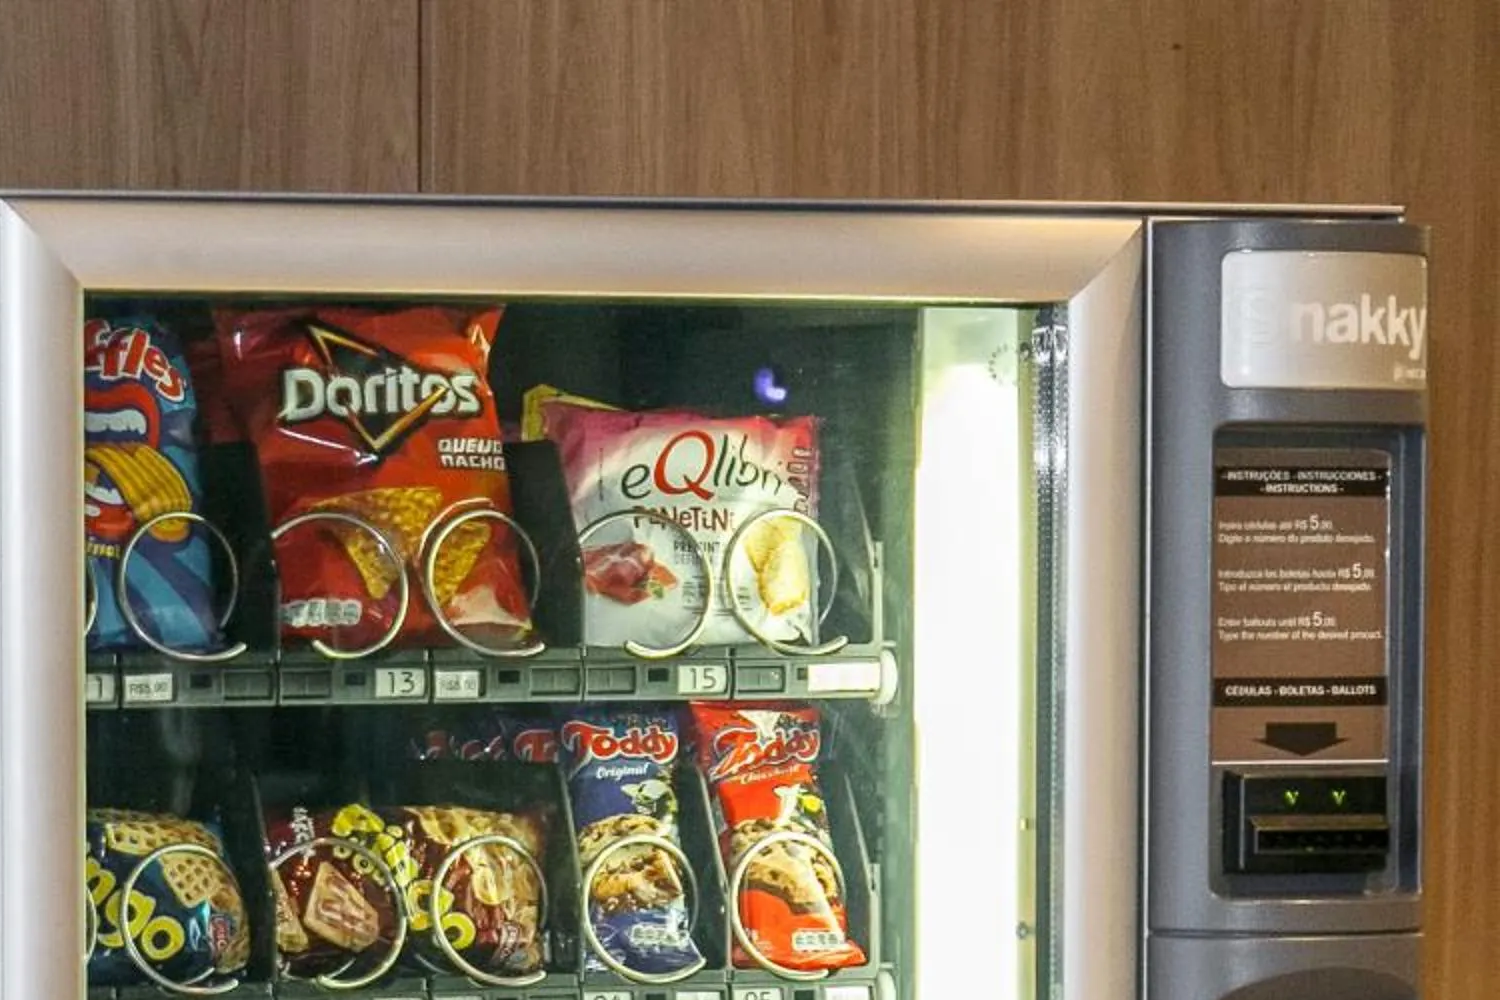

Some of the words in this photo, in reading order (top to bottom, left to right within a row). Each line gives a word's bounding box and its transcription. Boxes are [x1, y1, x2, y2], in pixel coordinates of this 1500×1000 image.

[1290, 292, 1427, 361] nakky
[84, 319, 187, 402] ffles
[277, 365, 481, 421] Doritos
[1297, 470, 1377, 481] INSTRUCCIONES
[1265, 483, 1338, 494] INSTRUCTIONS
[387, 671, 416, 694] 13
[687, 666, 718, 690] 15
[1279, 685, 1325, 696] BOLETAS
[1331, 685, 1377, 696] BALLOTS
[562, 719, 680, 778] Toddy
[708, 727, 821, 782] Toddy
[595, 761, 650, 782] Original
